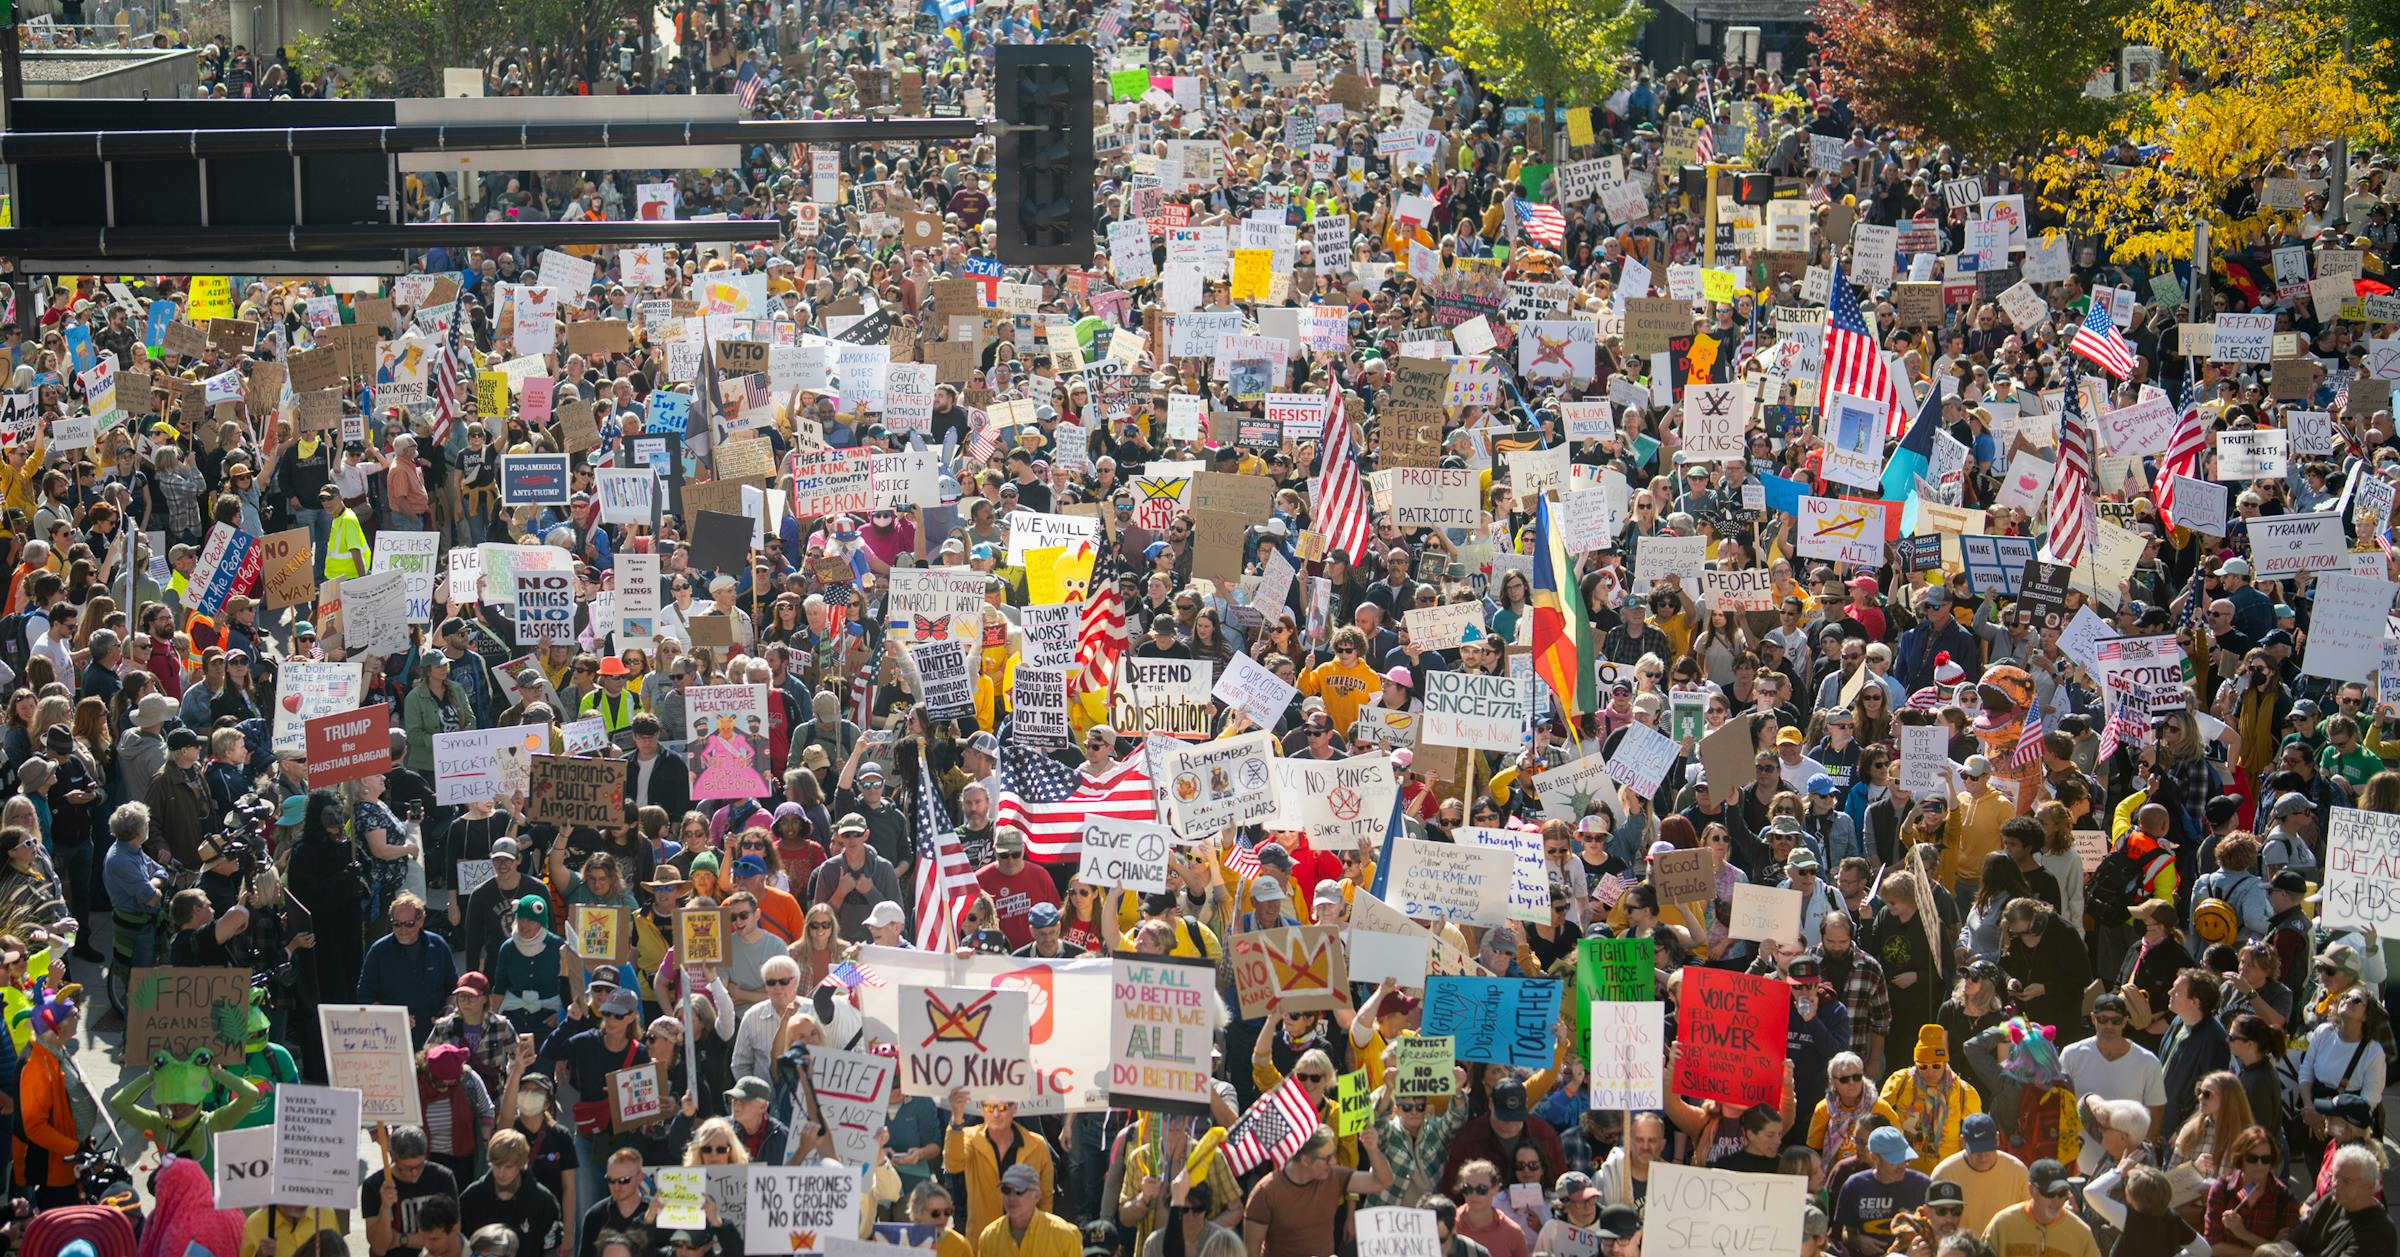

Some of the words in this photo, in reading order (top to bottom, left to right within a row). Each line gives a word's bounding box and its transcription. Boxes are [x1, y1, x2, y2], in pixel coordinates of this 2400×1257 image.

[1948, 181, 1982, 206] NO
[1975, 222, 1998, 234] ICE
[1975, 235, 1998, 247] ICE
[965, 260, 1002, 276] SPEAK
[1323, 254, 1347, 267] USA!
[1856, 275, 1890, 287] POTUS
[1776, 308, 1821, 323] LIBERTY
[2219, 317, 2273, 330] DEFEND
[720, 343, 764, 360] VETO
[2219, 346, 2271, 360] RESIST
[378, 385, 392, 394] NO
[393, 382, 423, 395] KINGS
[887, 394, 931, 406] HATRED
[887, 408, 927, 416] WITHOUT
[1269, 408, 1322, 422] RESIST!
[1397, 410, 1440, 424] FUTURE
[1398, 427, 1440, 441] FEMALE
[1702, 418, 1729, 434] NO
[2297, 416, 2319, 435] NO
[1239, 438, 1279, 447] AMERICA
[1685, 434, 1745, 450] KINGS
[2222, 435, 2255, 445] TRUTH
[2293, 432, 2331, 450] KINGS
[794, 452, 825, 466] THERE
[831, 451, 844, 461] IS
[2247, 446, 2278, 456] MELTS
[509, 463, 561, 472] PRO-AMERICA
[854, 461, 869, 471] IN
[2259, 460, 2274, 471] ICE
[795, 477, 823, 491] THIS
[825, 473, 869, 485] COUNTRY
[1402, 469, 1471, 487] PROTEST
[512, 488, 560, 497] ANTI-TRUMP
[798, 492, 867, 517] LEBRON
[1151, 499, 1173, 511] NO
[1807, 499, 1827, 514] NO
[1399, 508, 1473, 524] PATRIOTIC
[2268, 521, 2321, 537] TYRANNY
[265, 540, 288, 560] NO
[378, 537, 432, 551] TOGETHER
[1969, 545, 1991, 555] MAKE
[2001, 545, 2030, 556] ORWELL
[2289, 540, 2303, 550] OR
[2265, 554, 2337, 570] REVOLUTION
[518, 577, 568, 590] NO
[892, 578, 911, 591] THE
[918, 577, 948, 593] ONLY
[950, 580, 985, 596] ORANGE
[1708, 572, 1770, 591] PEOPLE
[1974, 573, 2004, 584] FICTION
[279, 583, 311, 601] WAY
[519, 591, 569, 608] KINGS
[623, 587, 652, 595] KINGS
[1725, 591, 1754, 599] OVER
[890, 594, 937, 614] MONARCH
[956, 596, 983, 613] WANT
[1718, 598, 1771, 611] PROFIT
[519, 608, 567, 621] NO
[1024, 606, 1070, 626] TRUMP
[1415, 610, 1440, 622] THE
[520, 622, 570, 638] FASCISTS
[1024, 623, 1068, 643] WORST
[915, 647, 930, 657] THE
[931, 641, 961, 656] PEOPLE
[918, 655, 963, 673] UNITED
[1034, 652, 1071, 667] SINCE
[922, 671, 936, 681] WILL
[937, 667, 966, 679] DEFEND
[1016, 672, 1062, 683] WORKERS
[1126, 661, 1191, 684] DEFEND
[925, 681, 968, 697] IMMIGRANT
[1016, 682, 1043, 692] SHOULD
[1326, 675, 1367, 692] MINNESOTA
[1428, 673, 1460, 693] NO
[1465, 676, 1515, 698] KING
[694, 687, 755, 700] AFFORDABLE
[926, 692, 970, 706] FAMILIES!
[1016, 690, 1063, 707] POWER
[693, 699, 757, 712] HEALTHCARE
[1426, 692, 1486, 716] SINCE
[1016, 710, 1038, 725] NOT
[1040, 711, 1064, 726] THE
[323, 718, 371, 742] TRUMP
[1015, 724, 1064, 735] BILLIONAIRES!
[1431, 718, 1447, 735] No
[1456, 719, 1483, 742] Kings
[341, 742, 356, 753] the
[308, 757, 351, 774] FAUSTIAN
[352, 747, 391, 765] BARGAIN
[539, 761, 615, 784] Immigrants
[1305, 773, 1326, 796] NO
[1337, 766, 1383, 790] KINGS
[556, 782, 601, 802] BUILT
[539, 800, 610, 823] America
[1314, 824, 1341, 837] SINCE
[1351, 817, 1384, 835] 1776
[2333, 822, 2376, 841] PARTY
[1086, 825, 1131, 848] GIVE
[1087, 859, 1101, 879] A
[1108, 860, 1163, 882] CHANCE
[1659, 854, 1701, 875] Good
[1659, 879, 1708, 900] Trouble
[1589, 942, 1628, 961] FIGHT
[1127, 965, 1159, 985] WE
[1161, 969, 1190, 988] ALL
[1236, 960, 1268, 993] NO
[1602, 966, 1638, 983] THOSE
[155, 976, 245, 1011] FROGS
[1730, 975, 1767, 997] YOUR
[1115, 982, 1136, 1001] DO
[1141, 985, 1202, 1008] BETTER
[1700, 988, 1750, 1014] VOICE
[1124, 1002, 1174, 1025] WHEN
[1178, 1004, 1206, 1026] WE
[1614, 1005, 1638, 1024] NO
[1731, 1014, 1759, 1030] NO
[1126, 1023, 1197, 1065] ALL
[1403, 1037, 1448, 1049] PROTECT
[1691, 1020, 1761, 1052] POWER
[1400, 1050, 1453, 1064] freedom
[1614, 1045, 1636, 1061] NO
[911, 1053, 953, 1087] NO
[963, 1053, 1027, 1088] KING
[1113, 1063, 1139, 1086] DO
[1143, 1066, 1208, 1094] BETTER
[1413, 1066, 1433, 1078] NO
[1399, 1077, 1450, 1094] KINGS
[1681, 1071, 1731, 1096] SILENCE
[1741, 1082, 1775, 1101] YOU!
[1592, 1090, 1615, 1108] NO
[1619, 1090, 1657, 1108] KINGS
[839, 1105, 882, 1123] NOT
[846, 1132, 867, 1150] US
[755, 1176, 777, 1193] NO
[786, 1175, 852, 1192] THRONES
[761, 1193, 782, 1210] NO
[793, 1192, 848, 1210] CROWNS
[1650, 1174, 1797, 1213] WORST
[1859, 1197, 1894, 1211] SEIU
[768, 1210, 788, 1227] NO
[792, 1209, 834, 1227] KINGS
[1375, 1211, 1423, 1235] FIGHT
[1665, 1216, 1796, 1257] SEQUEL
